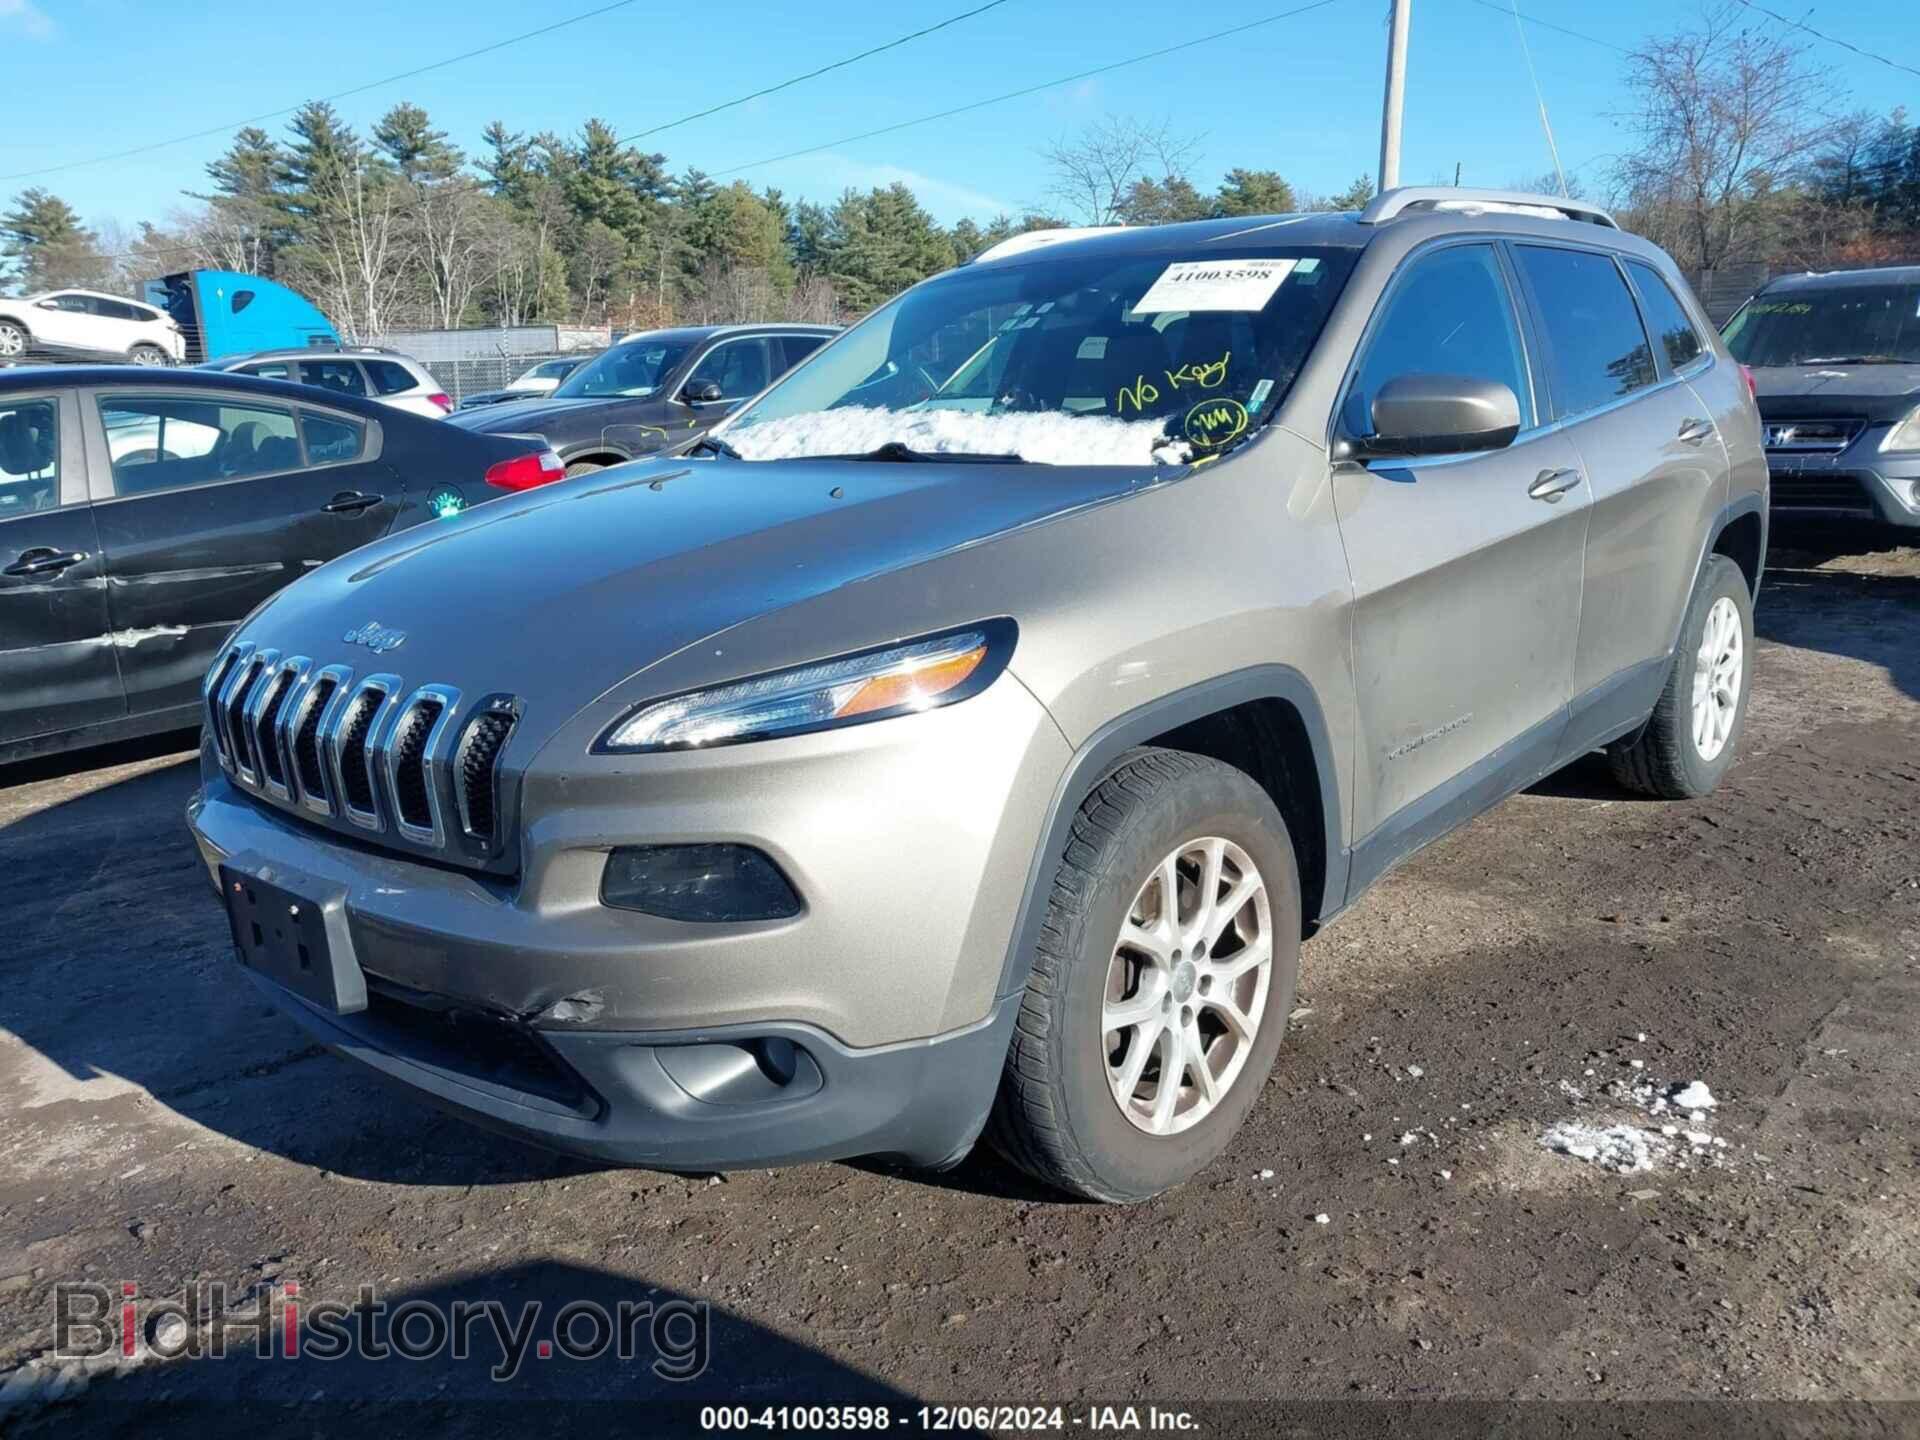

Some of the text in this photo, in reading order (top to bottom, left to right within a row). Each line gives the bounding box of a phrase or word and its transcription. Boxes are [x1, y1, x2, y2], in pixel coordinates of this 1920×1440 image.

[1171, 269, 1272, 282] 41003598
[1117, 374, 1159, 413] No
[343, 621, 407, 654] Jeep
